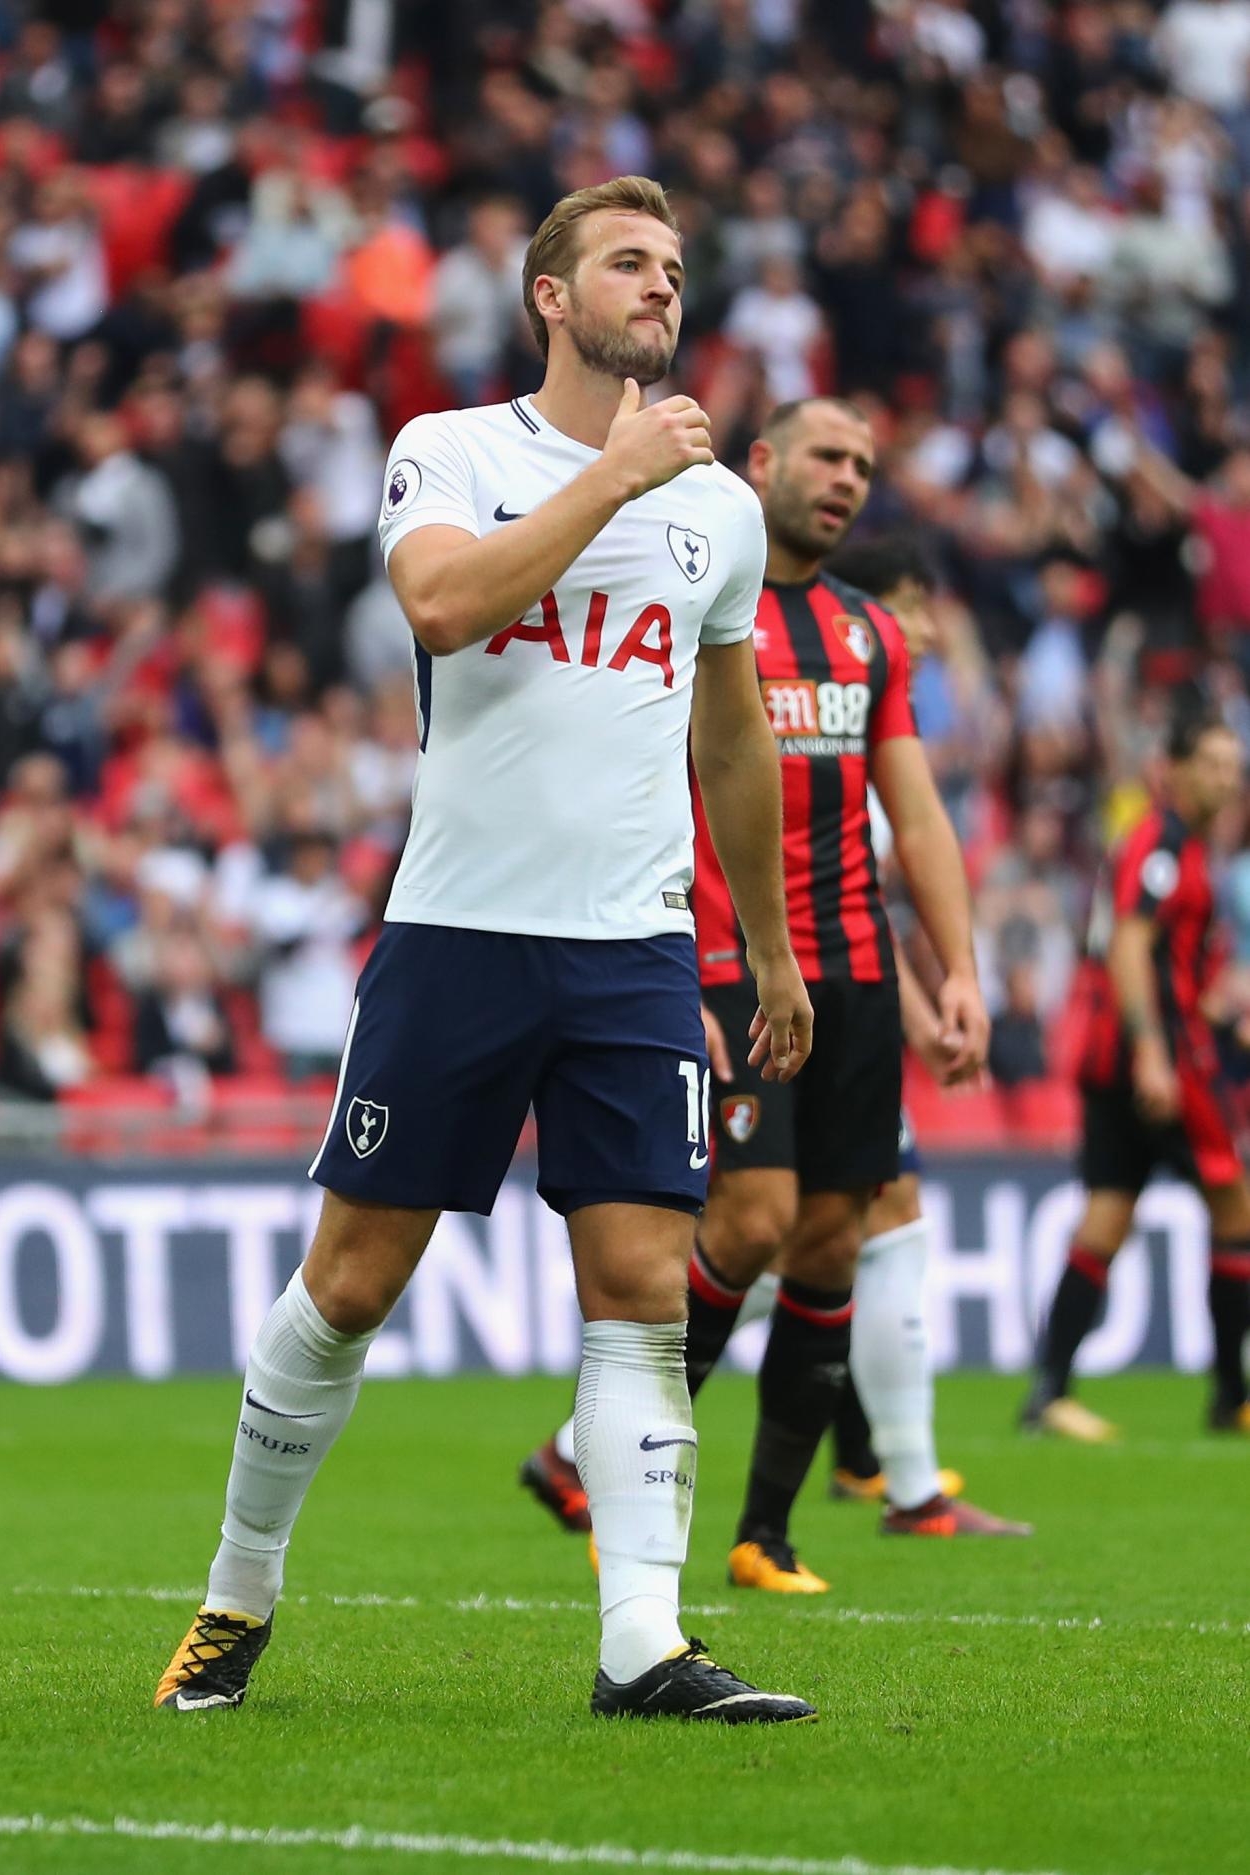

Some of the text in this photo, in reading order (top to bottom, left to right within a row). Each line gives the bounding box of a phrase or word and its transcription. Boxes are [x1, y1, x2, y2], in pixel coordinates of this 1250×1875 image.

[484, 589, 674, 689] AIA
[239, 1421, 312, 1455] SPURS
[644, 1470, 693, 1490] SPU
